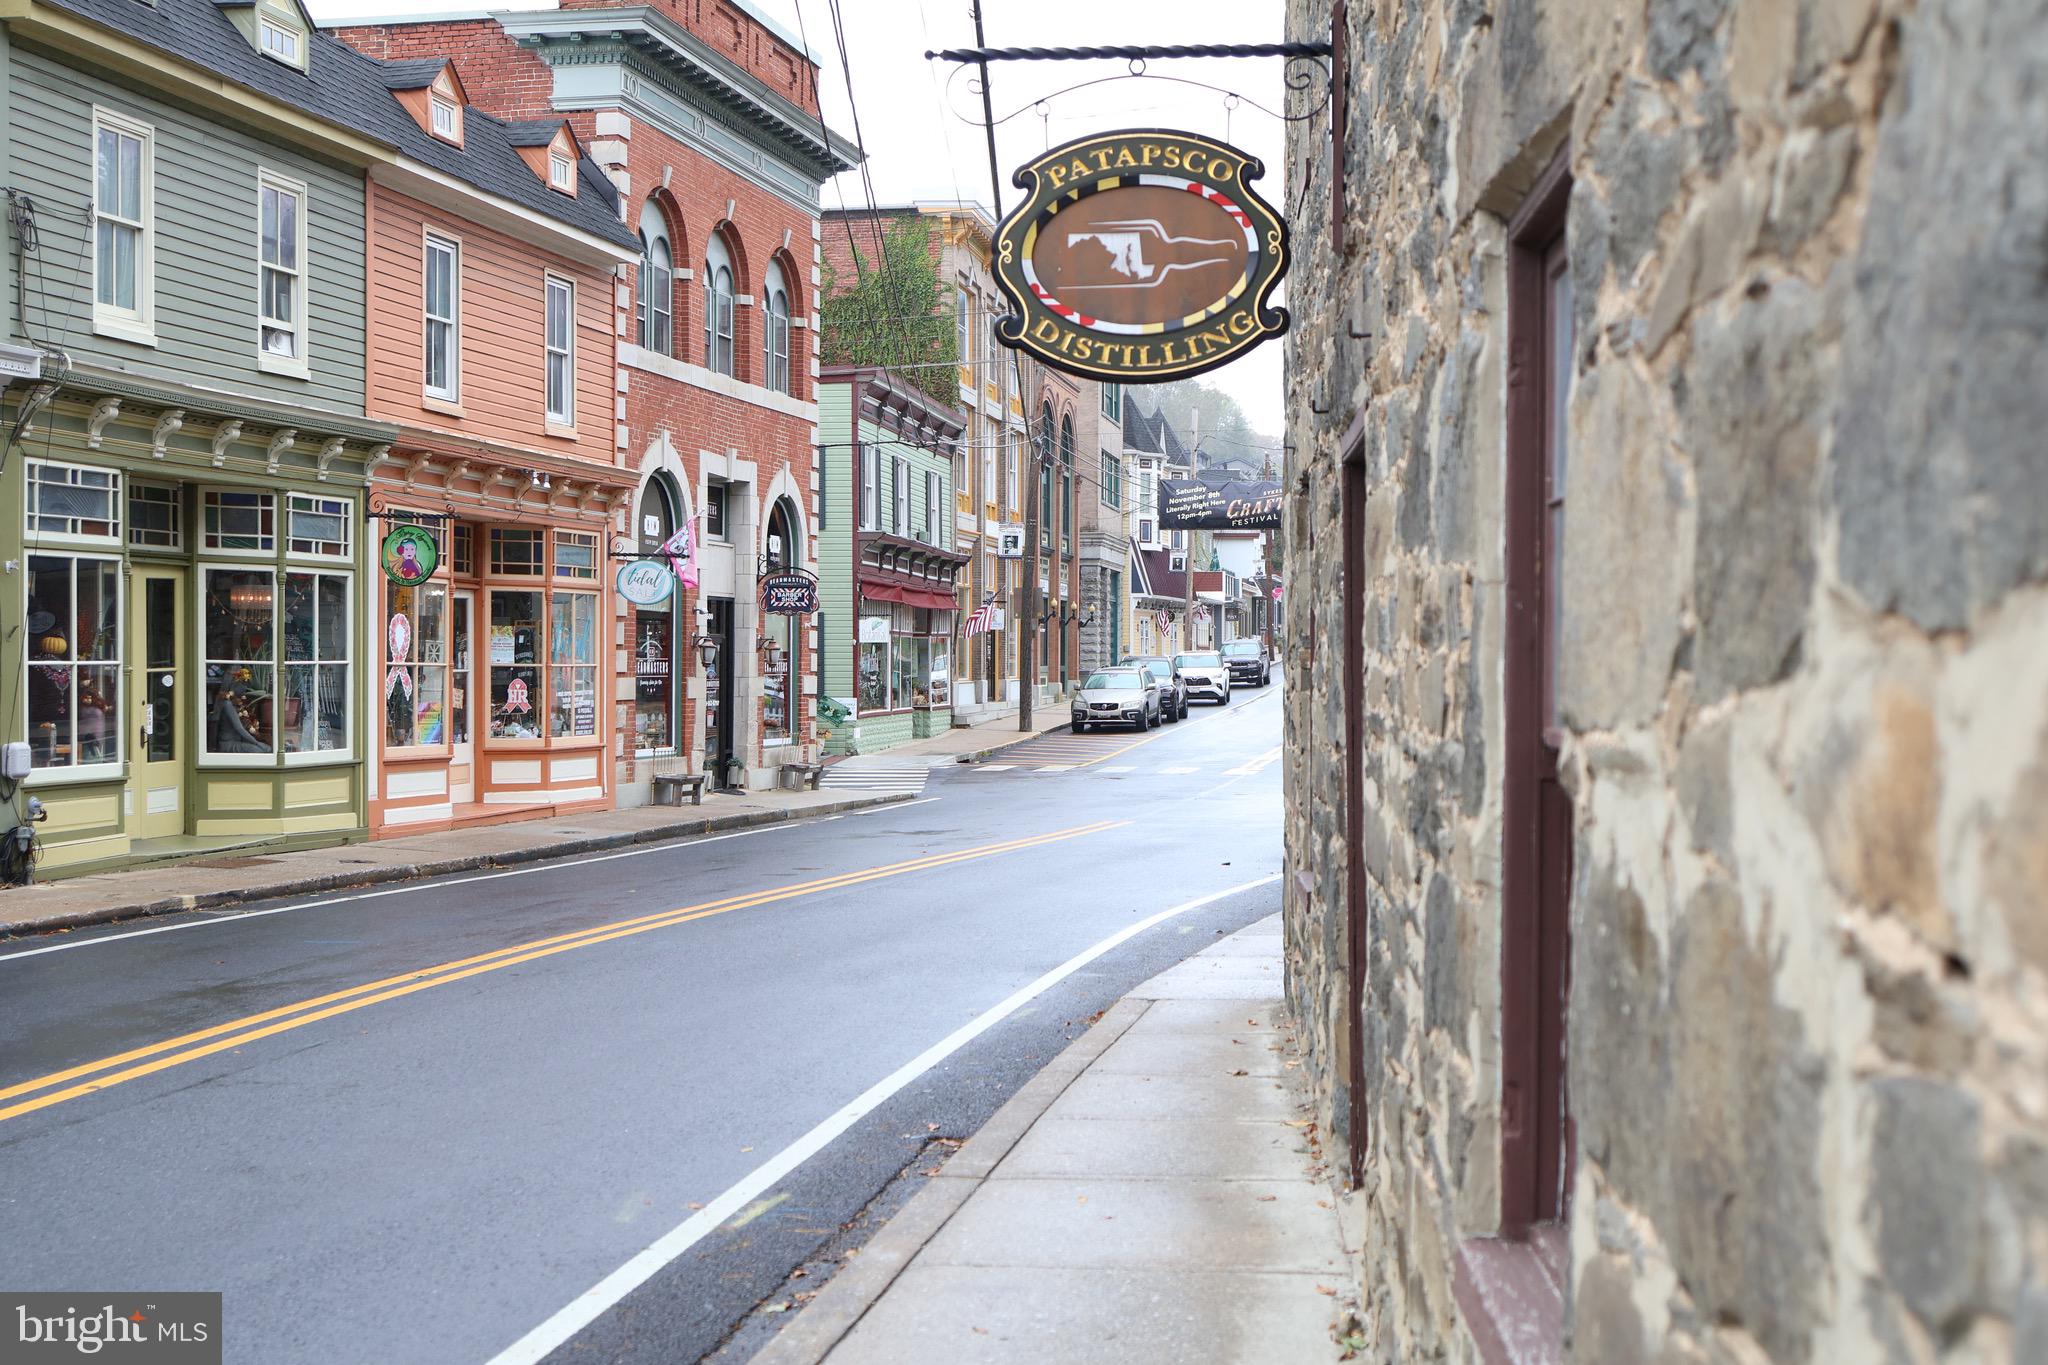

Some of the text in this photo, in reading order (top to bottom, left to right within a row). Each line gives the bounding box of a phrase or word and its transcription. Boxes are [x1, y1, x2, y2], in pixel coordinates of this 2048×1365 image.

[1044, 143, 1234, 190] PATAPSCO
[1030, 310, 1256, 368] DISTILLING
[1168, 490, 1220, 505] November 8th
[1175, 485, 1207, 496] Saturday
[1166, 499, 1226, 514] Literally Right Here
[1177, 509, 1212, 520] 12pm-4pm
[1231, 513, 1278, 527] FESTIVAL
[627, 568, 664, 588] tidal
